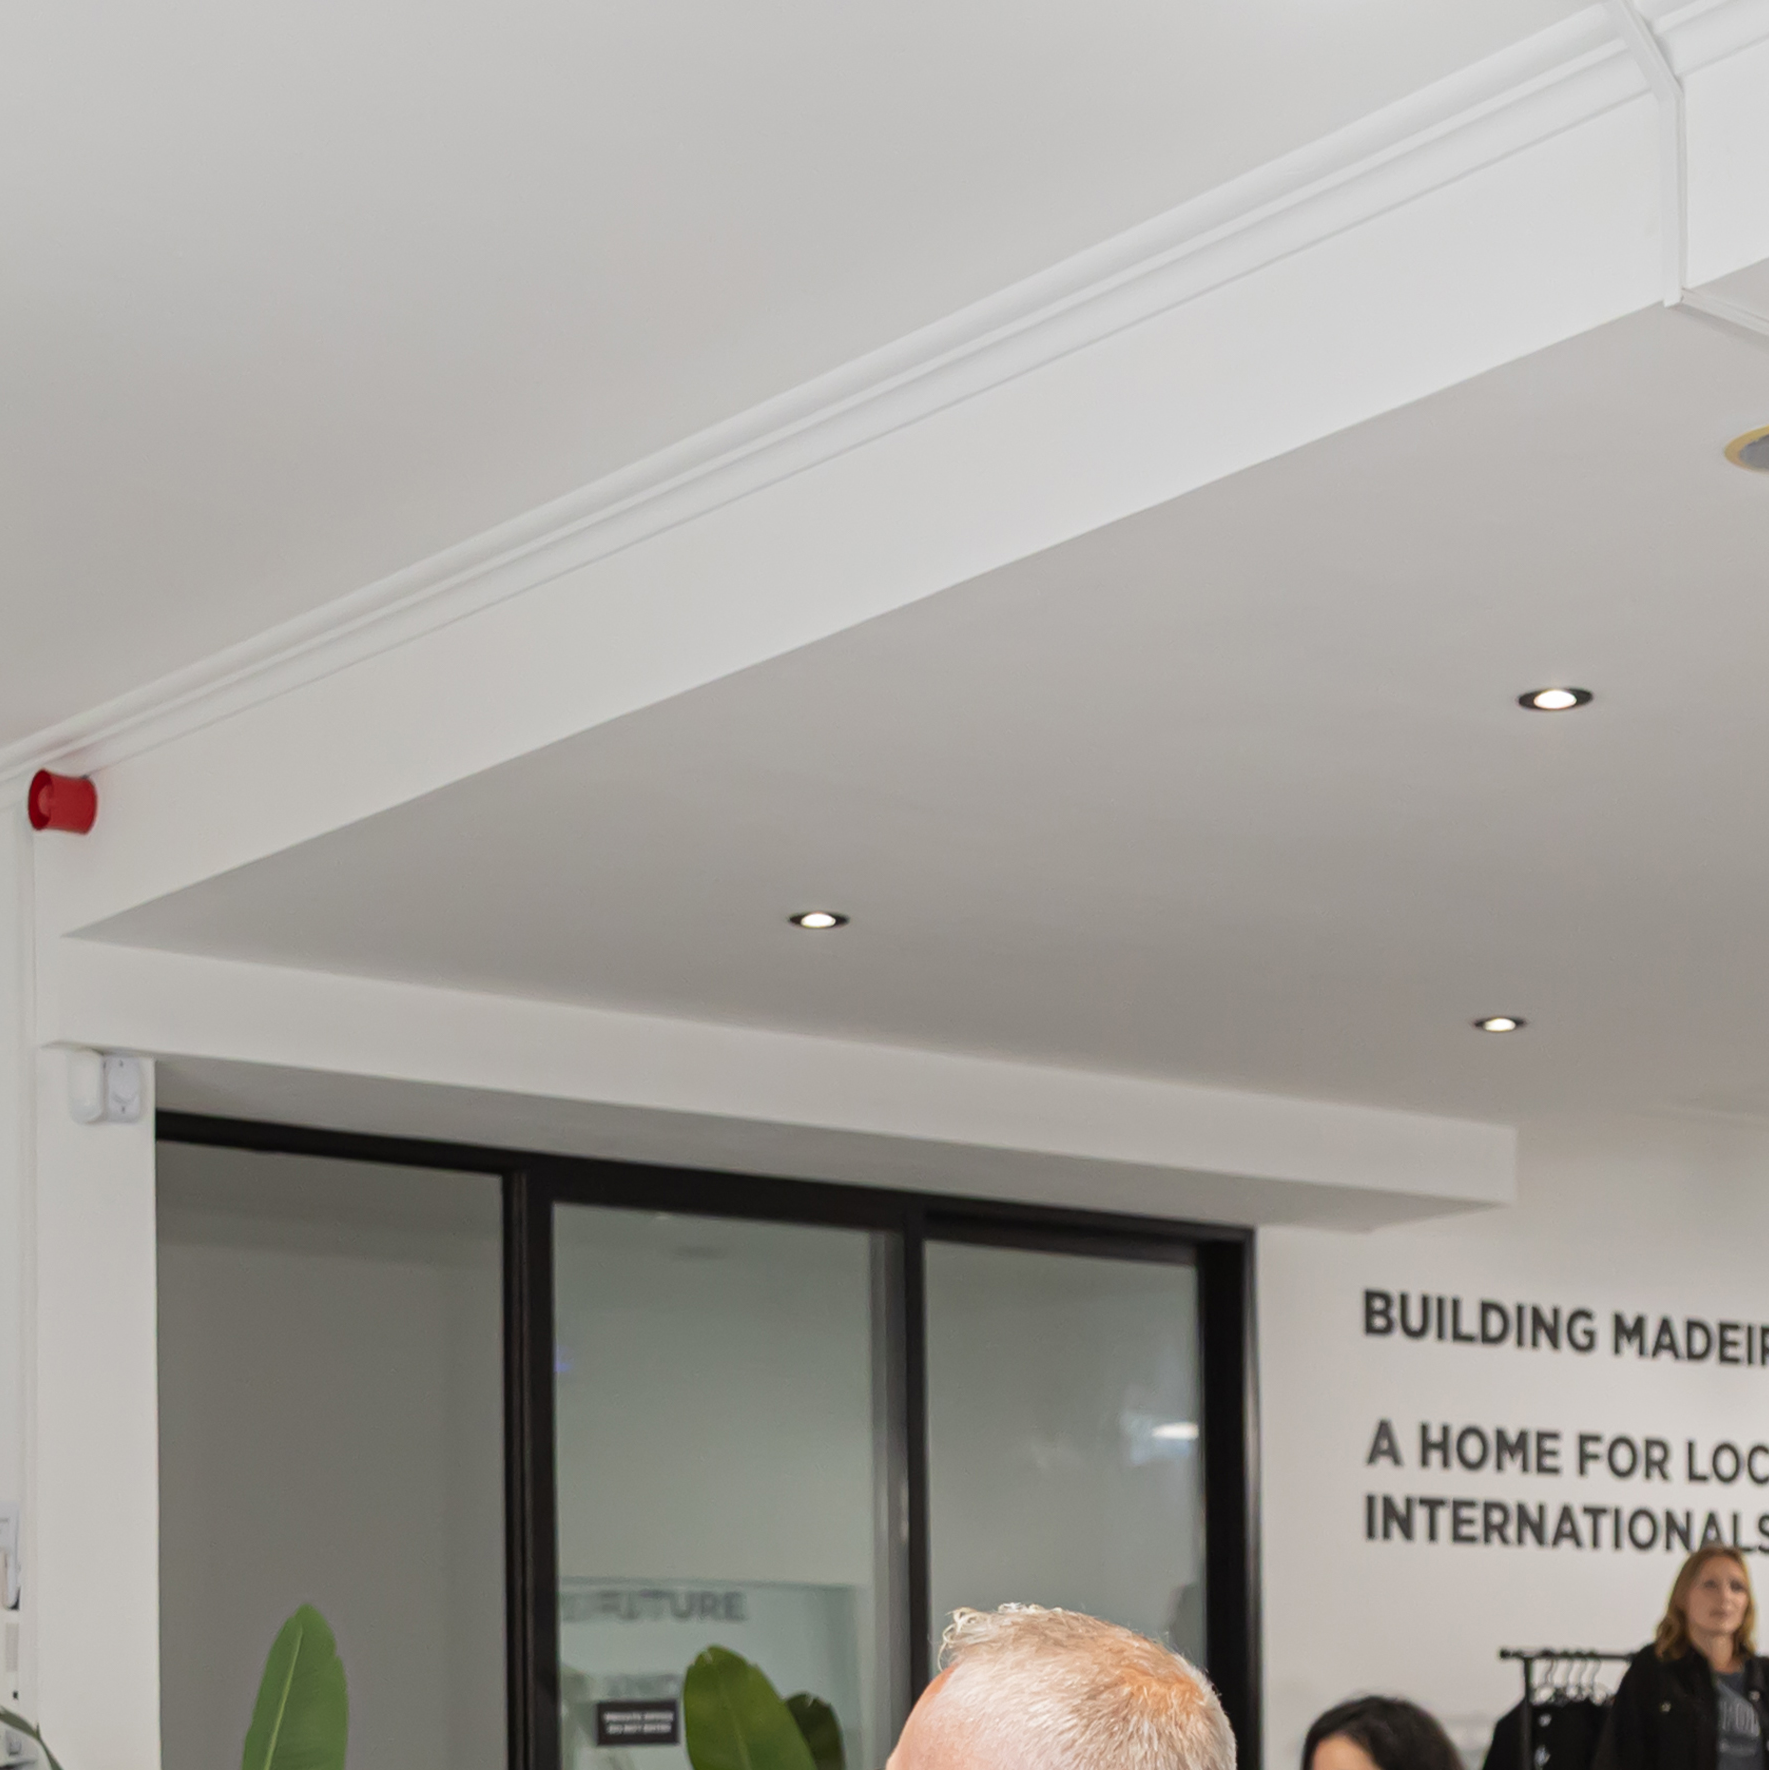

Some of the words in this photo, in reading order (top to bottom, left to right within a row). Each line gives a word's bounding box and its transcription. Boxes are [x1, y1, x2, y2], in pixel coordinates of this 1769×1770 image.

[1363, 1288, 1597, 1352] BUILDING
[1366, 1418, 1403, 1467] A
[1420, 1422, 1561, 1475] HOME
[1578, 1432, 1672, 1483] FOR
